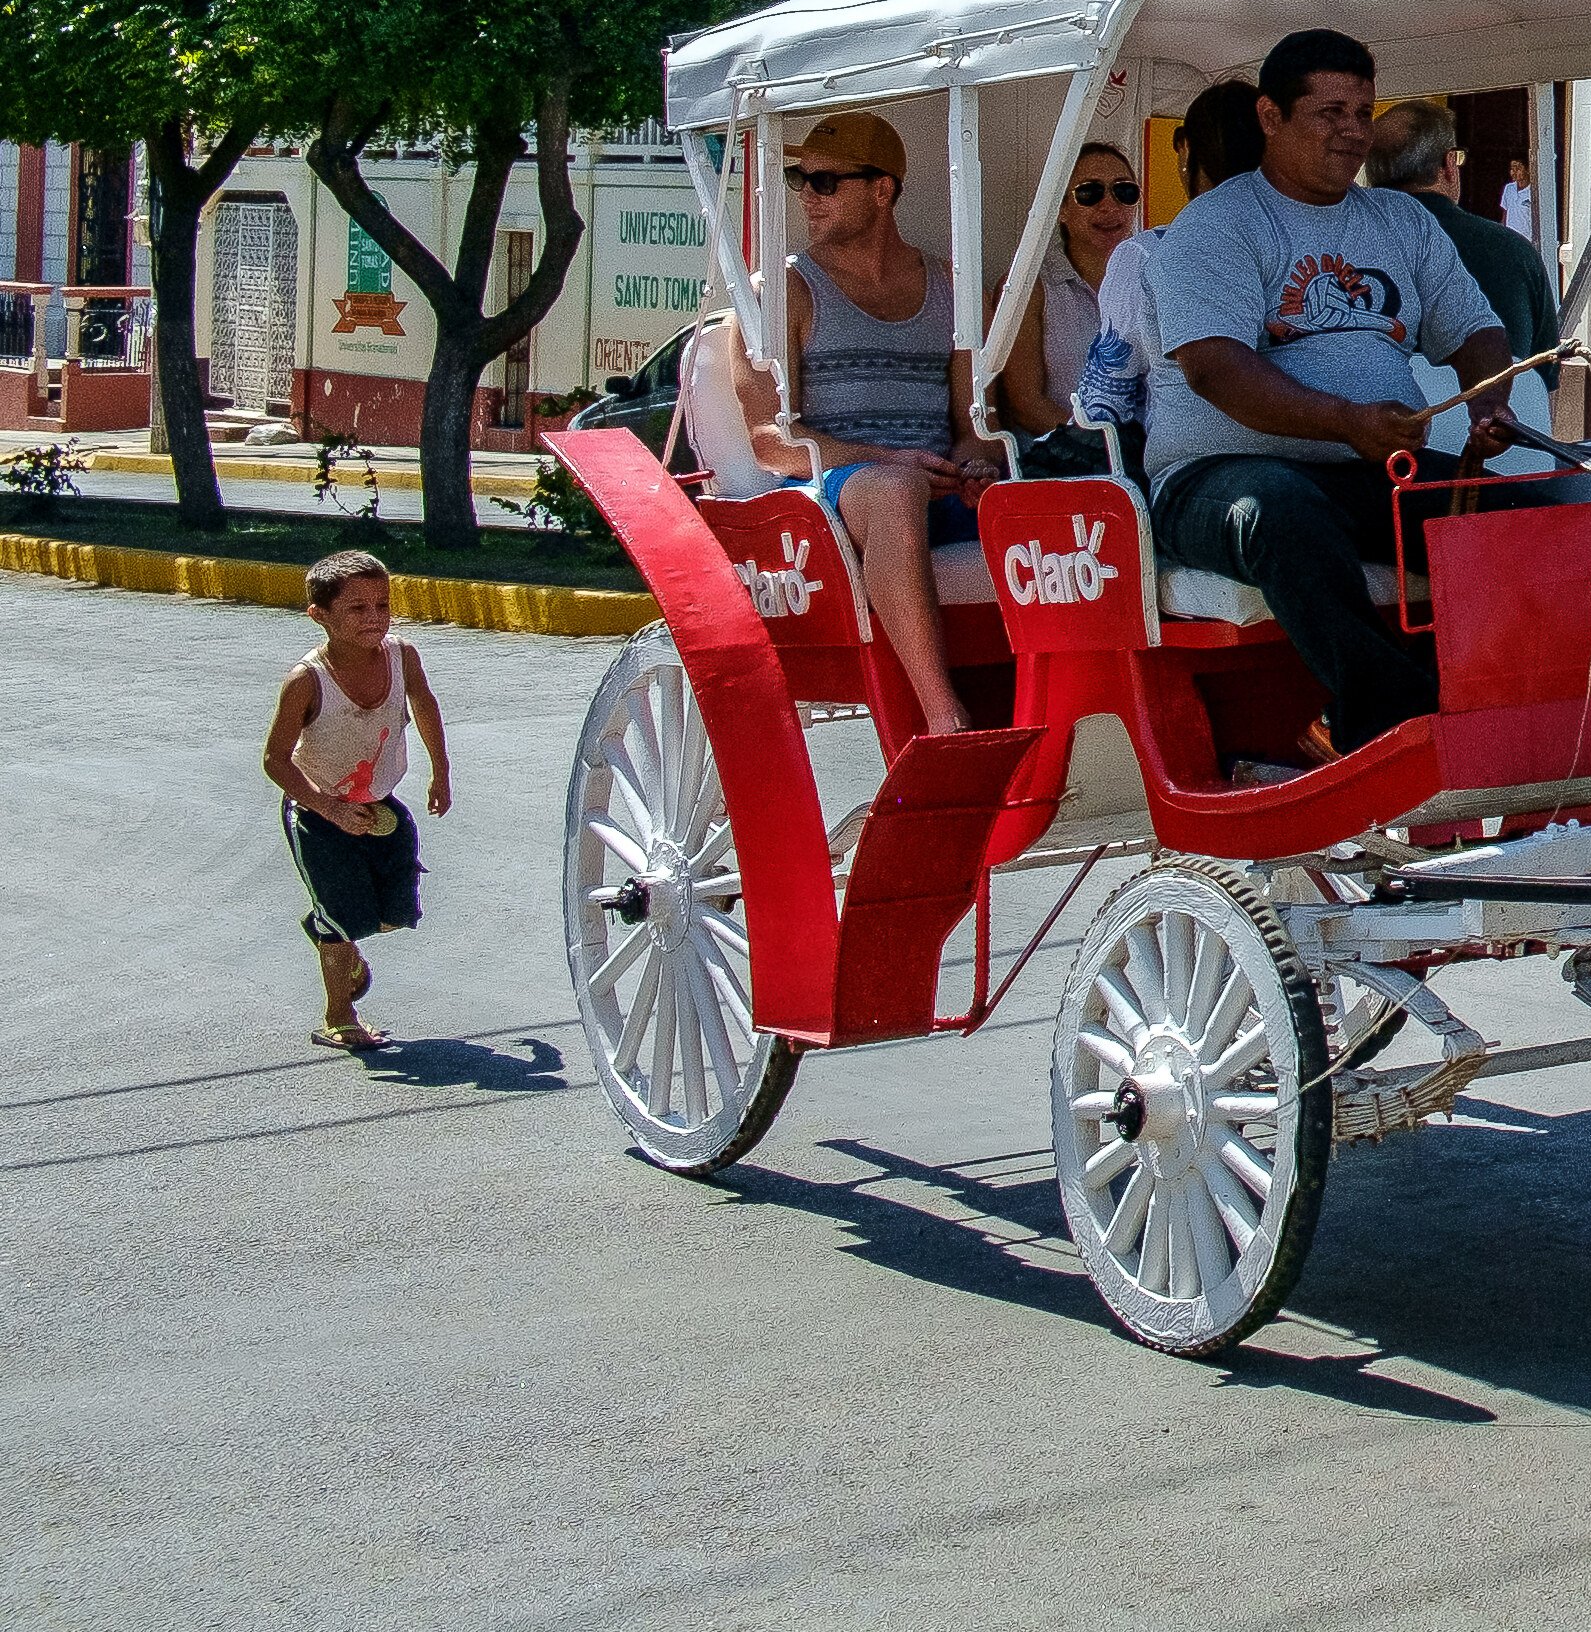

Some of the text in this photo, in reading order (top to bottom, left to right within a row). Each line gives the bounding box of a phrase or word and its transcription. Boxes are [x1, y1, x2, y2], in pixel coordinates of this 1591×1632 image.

[619, 211, 706, 247] UNIVERSIDAD
[615, 275, 658, 309] SANTO
[1005, 538, 1106, 606] Claro
